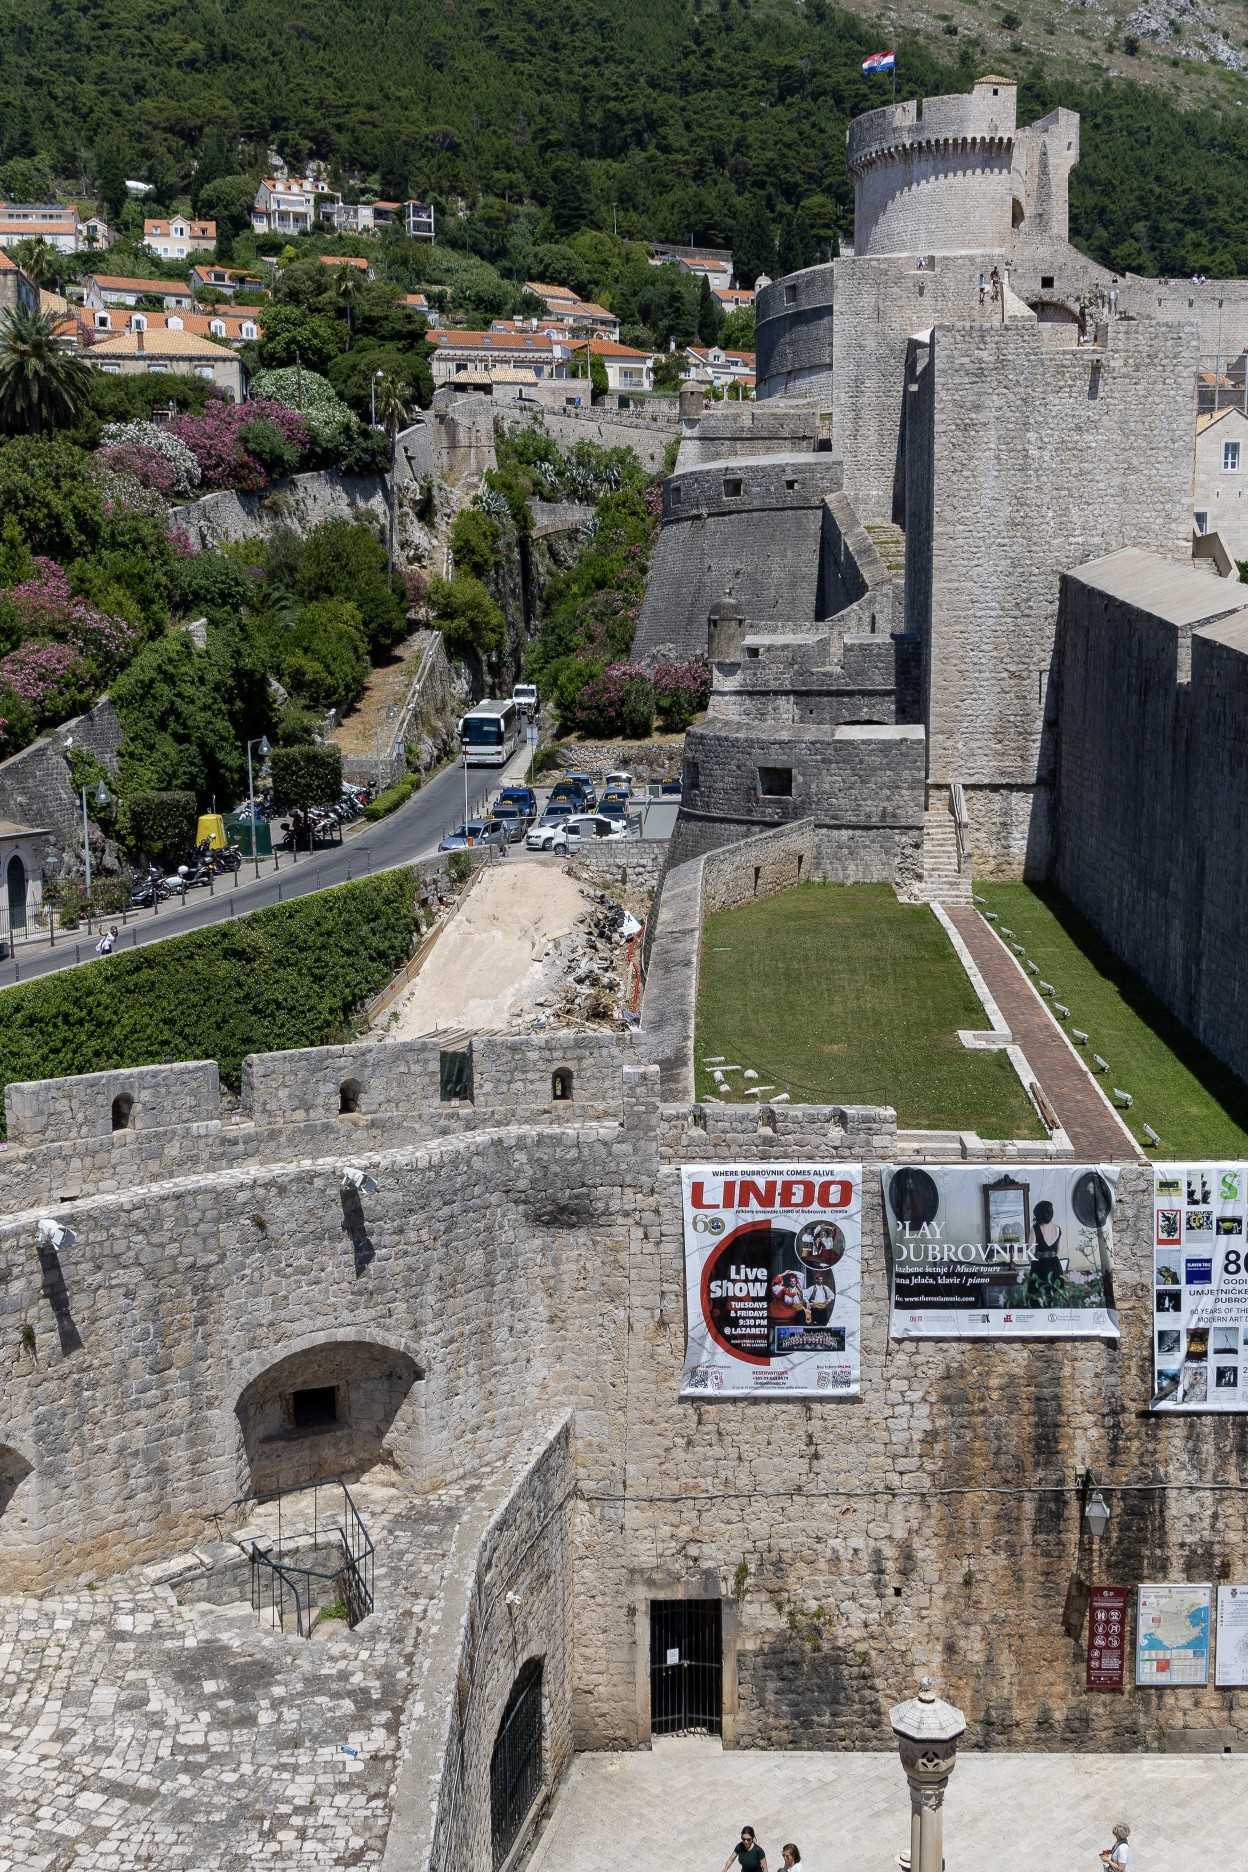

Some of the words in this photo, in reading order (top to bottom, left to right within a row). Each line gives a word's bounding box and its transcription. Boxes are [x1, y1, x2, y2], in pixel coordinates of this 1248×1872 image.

[1223, 1249, 1248, 1275] 8
[730, 1265, 768, 1280] Live
[955, 1265, 978, 1273] Music
[980, 1265, 1000, 1273] tours
[938, 1276, 961, 1284] klavir
[967, 1276, 990, 1286] piano
[710, 1280, 768, 1298] Show
[1200, 1307, 1223, 1315] YEARS
[1197, 1316, 1228, 1324] MODERN
